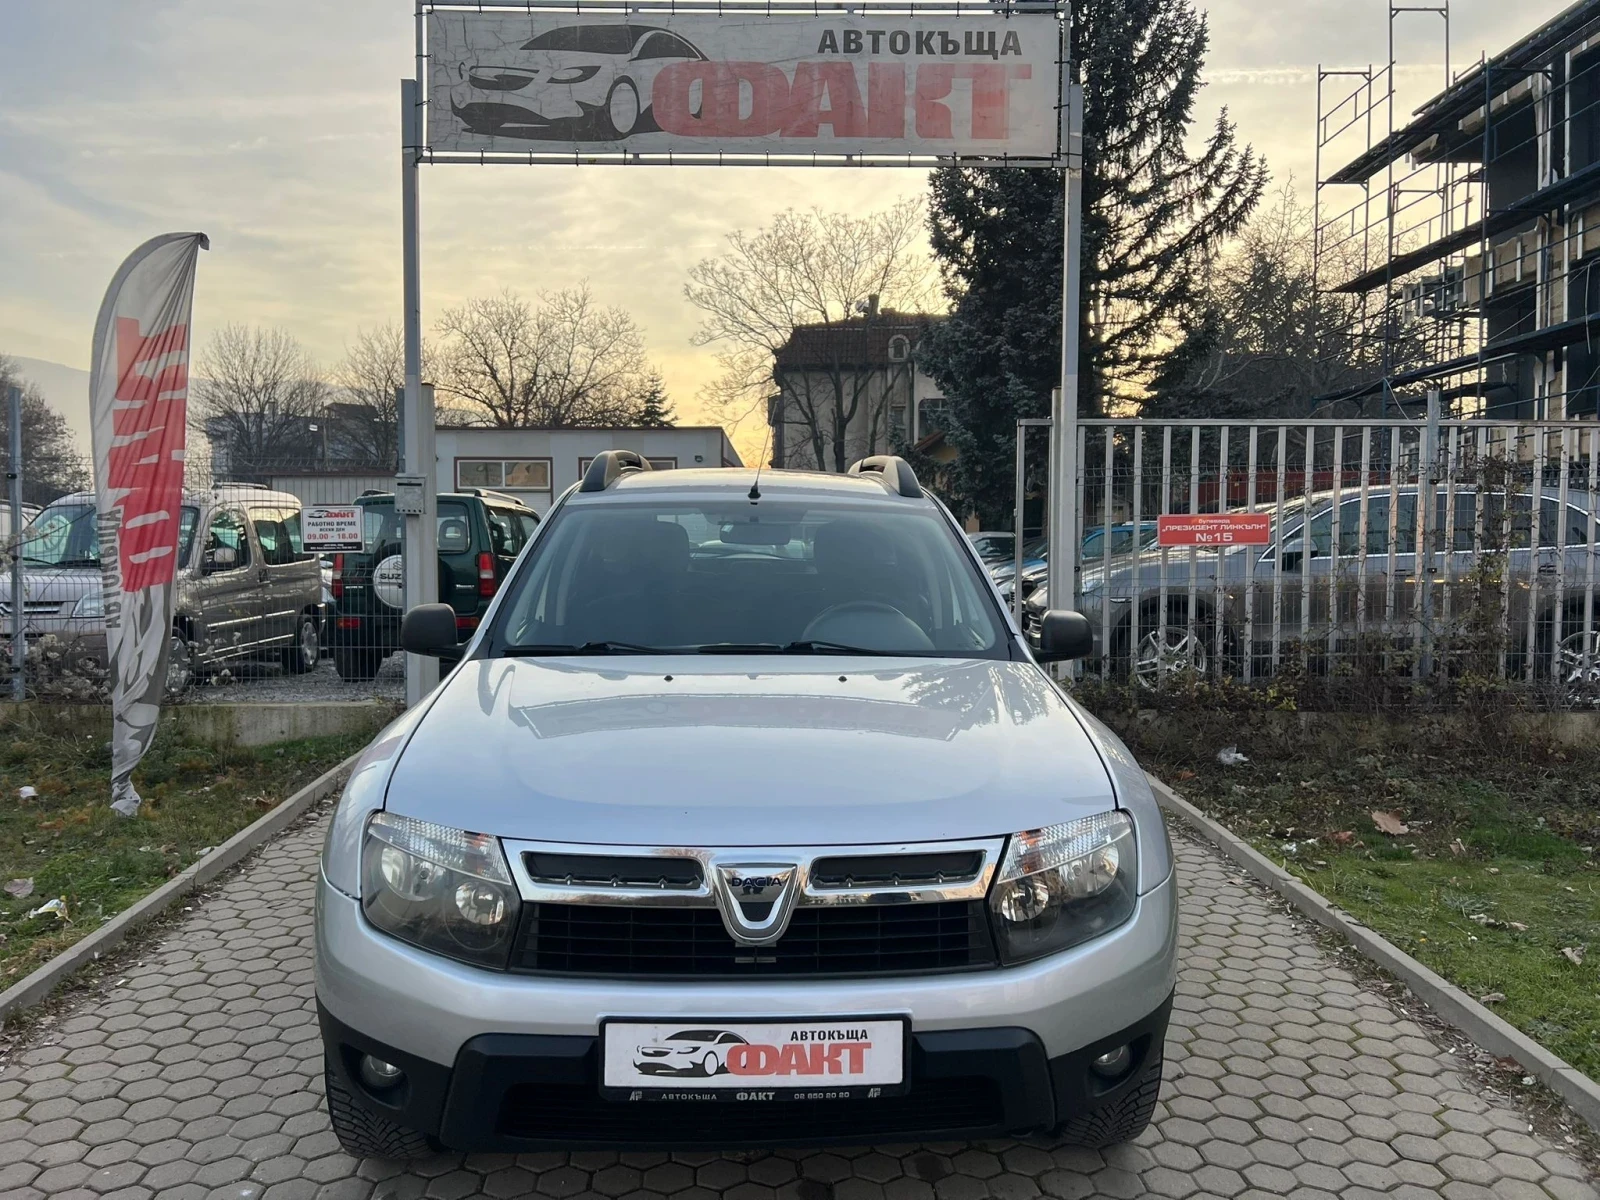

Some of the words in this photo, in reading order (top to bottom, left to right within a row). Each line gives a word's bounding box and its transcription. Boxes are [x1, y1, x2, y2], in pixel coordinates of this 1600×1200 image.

[817, 29, 1022, 59] АВТОКЪЩА
[651, 60, 1032, 140] ФАКТ
[731, 877, 782, 887] DACIA
[790, 1029, 868, 1041] АВТОКЪЩА
[726, 1042, 871, 1076] ФАКТ
[736, 1092, 775, 1100] ФАКТ
